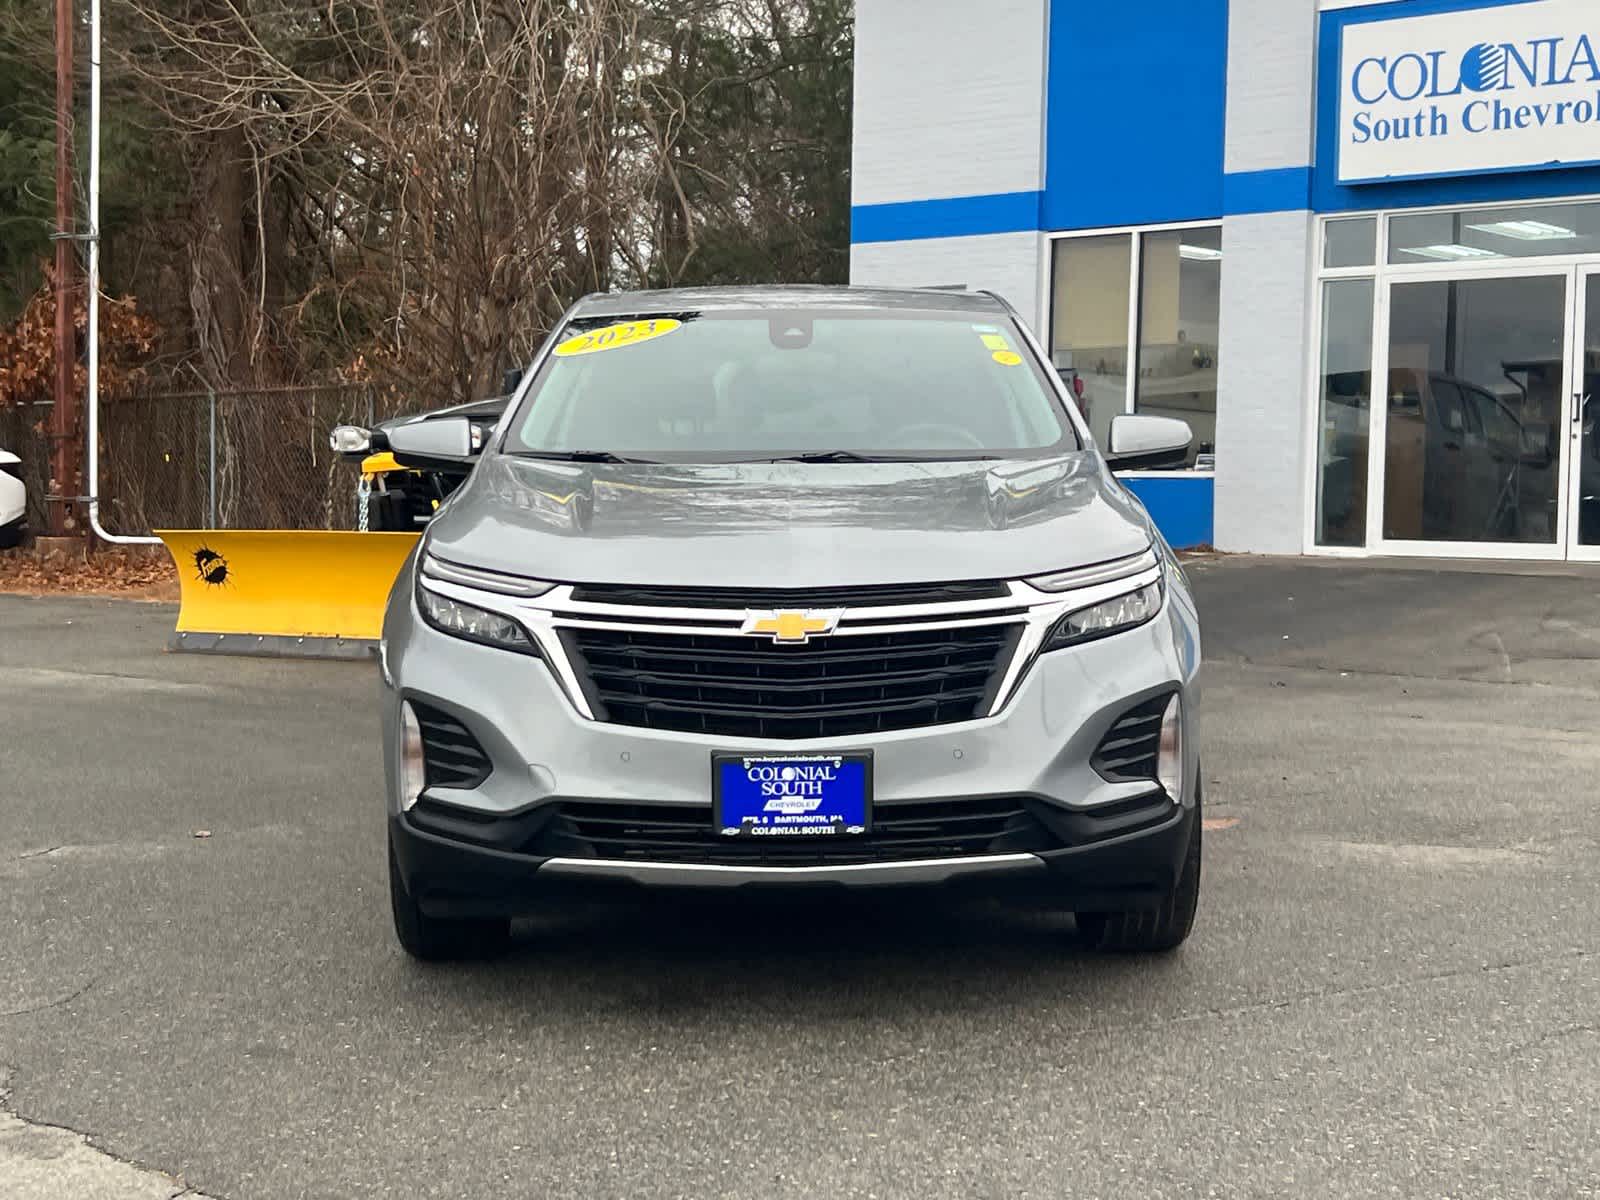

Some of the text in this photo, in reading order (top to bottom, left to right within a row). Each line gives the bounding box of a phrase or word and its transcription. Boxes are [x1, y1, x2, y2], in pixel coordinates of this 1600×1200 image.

[1352, 105, 1448, 144] South
[578, 321, 656, 350] 2023
[748, 766, 836, 781] COLONIAL
[762, 781, 823, 796] SOUTH
[751, 826, 836, 835] COLONIAL SOUTH
